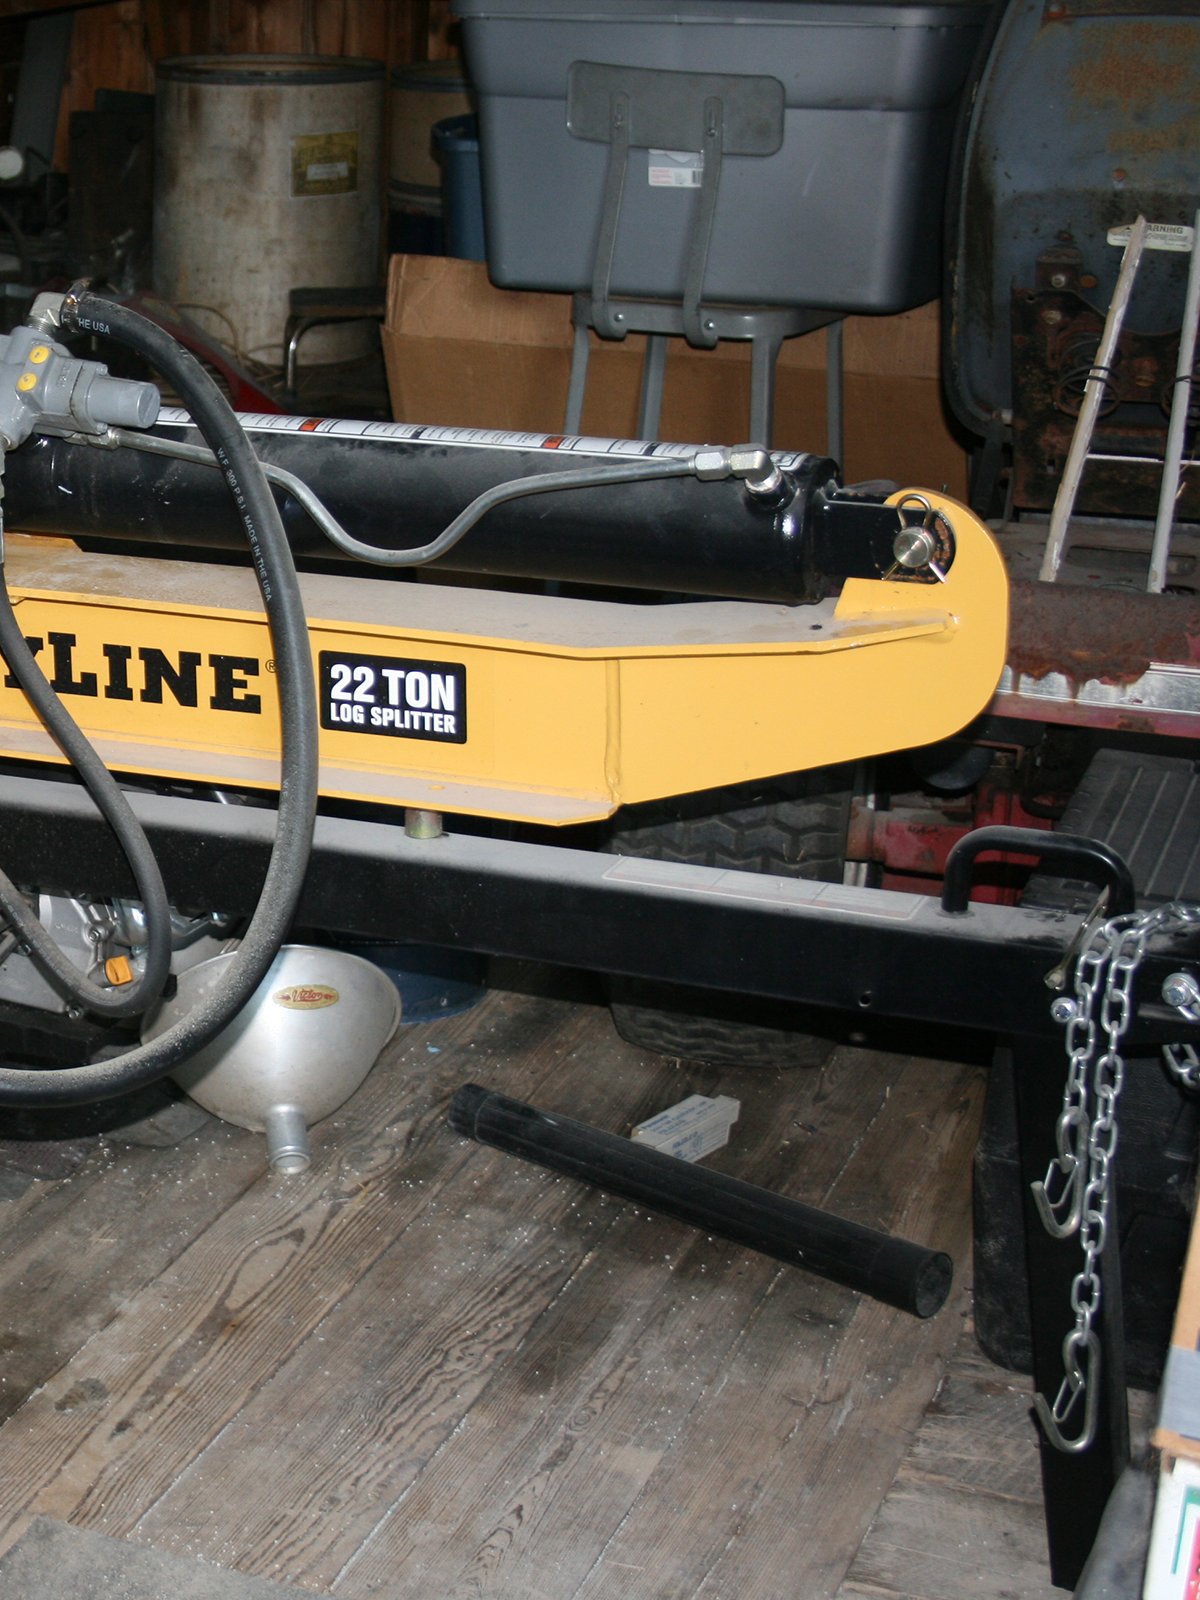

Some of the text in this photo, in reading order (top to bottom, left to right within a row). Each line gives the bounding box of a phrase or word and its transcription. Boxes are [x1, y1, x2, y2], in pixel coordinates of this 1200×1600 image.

[1144, 224, 1184, 234] ARNING
[76, 317, 91, 329] HE
[92, 320, 111, 335] USA
[226, 469, 238, 488] 300
[244, 515, 258, 543] MADE
[253, 545, 262, 557] IN
[256, 557, 268, 579] THE
[262, 578, 273, 602] USA
[330, 663, 456, 711] 22 TON
[330, 702, 456, 734] LOG SPLITTER
